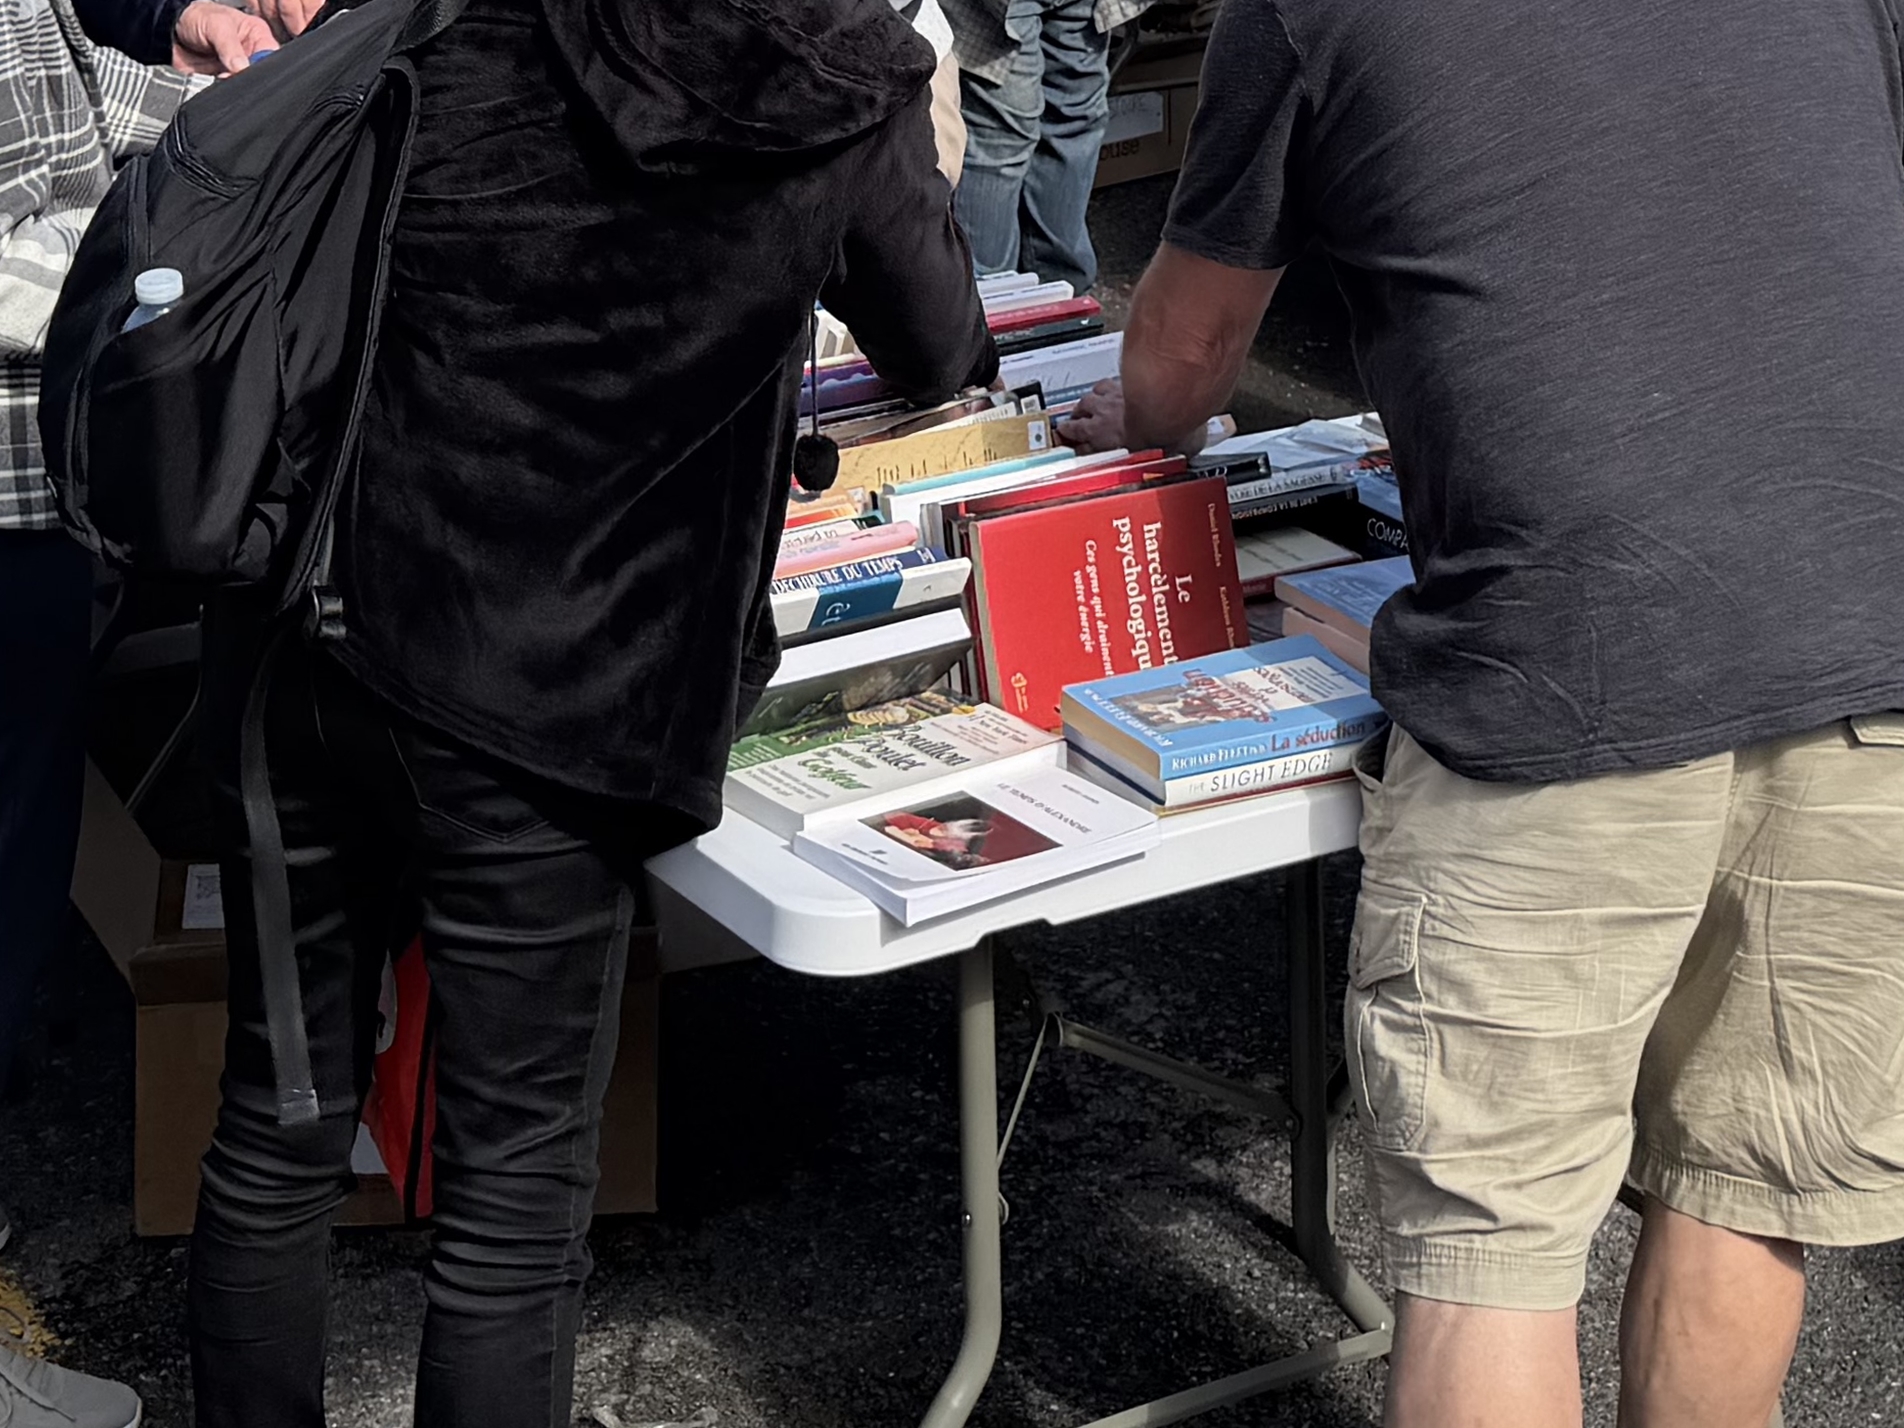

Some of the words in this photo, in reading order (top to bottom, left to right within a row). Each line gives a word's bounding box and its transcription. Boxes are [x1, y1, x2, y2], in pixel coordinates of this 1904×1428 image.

[843, 560, 863, 578] DU
[864, 553, 903, 575] TEMPS
[1143, 521, 1179, 667] harcèlement
[1175, 574, 1193, 603] Le
[1270, 733, 1291, 751] La
[1295, 720, 1366, 744] séduction
[1210, 763, 1274, 793] SLIGHT
[1280, 751, 1333, 779] EDGE
